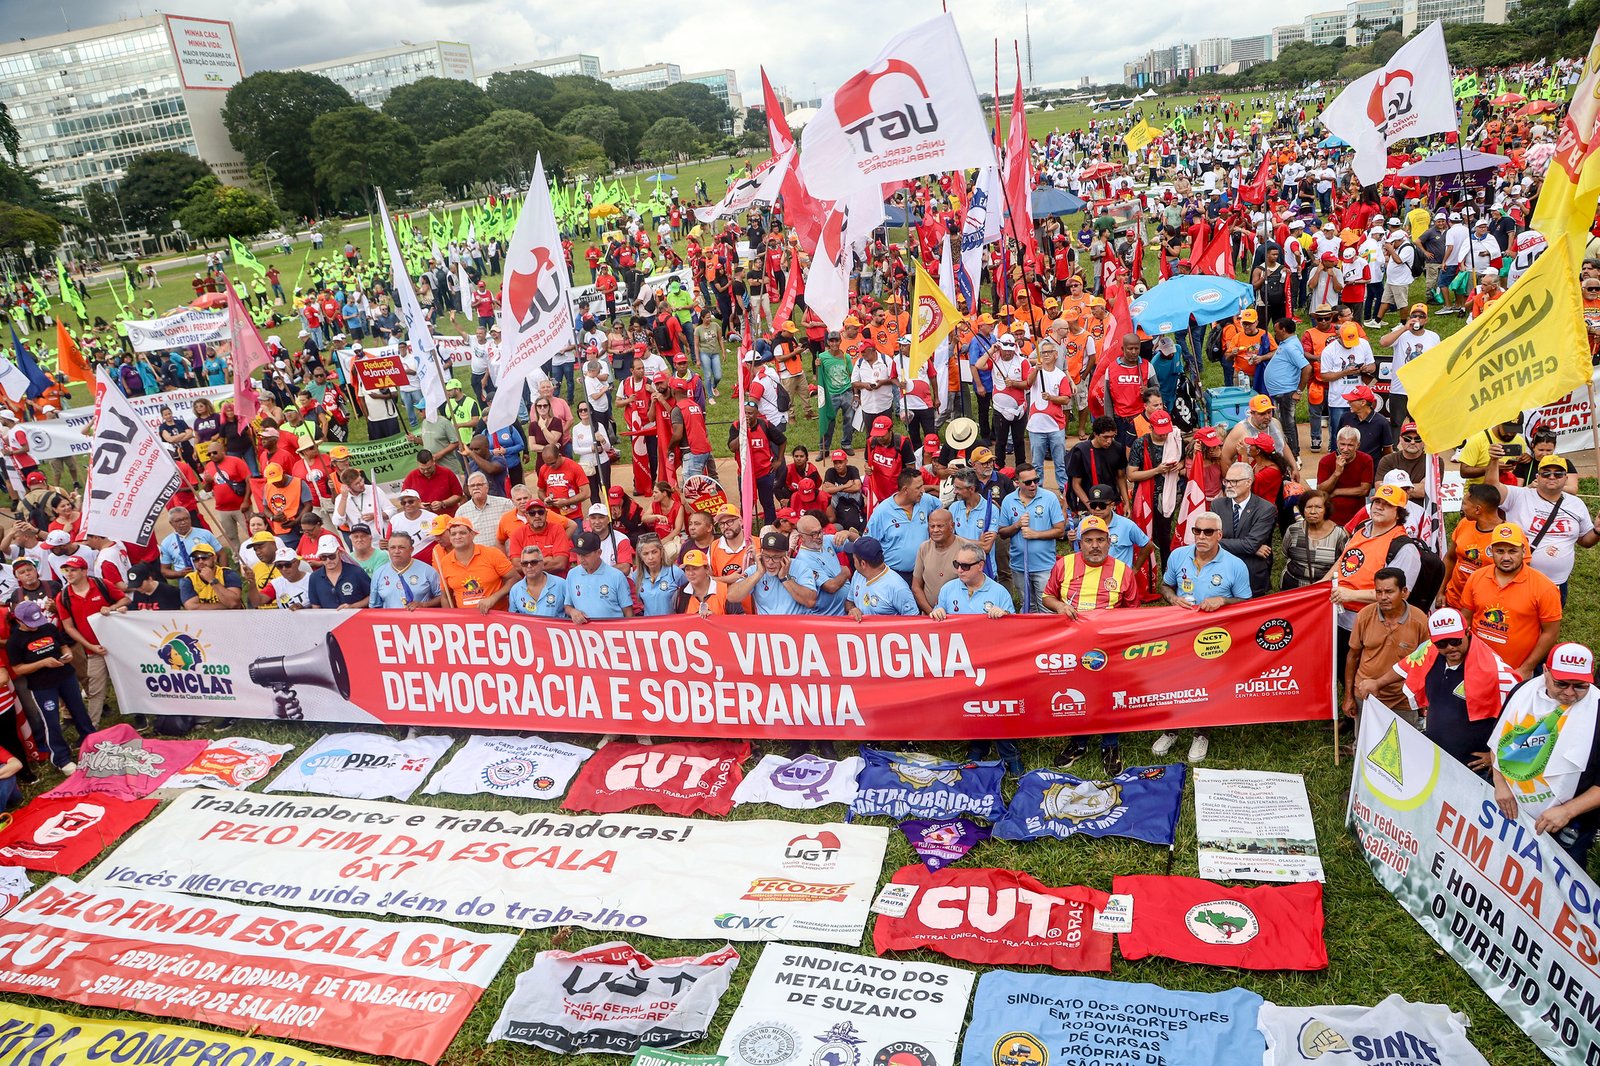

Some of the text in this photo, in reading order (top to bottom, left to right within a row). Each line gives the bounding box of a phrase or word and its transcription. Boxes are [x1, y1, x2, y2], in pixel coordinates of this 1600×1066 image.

[184, 29, 203, 37] MINHA
[188, 40, 207, 48] MINHA
[182, 58, 208, 66] HABITAÇÃO
[164, 325, 190, 337] CONTRA
[166, 338, 175, 346] NO
[363, 360, 393, 370] Redução
[369, 367, 400, 377] Jornada
[1118, 375, 1139, 383] CUT
[390, 448, 418, 460] ESCALA
[872, 452, 895, 465] CUT
[373, 463, 394, 474] 6X1
[1433, 617, 1455, 628] LULA
[1479, 620, 1509, 633] CONCLAT
[1202, 634, 1224, 642] NCST
[1256, 634, 1292, 650] SINDICAL
[371, 622, 987, 687] EMPREGO, DIREITOS, VIDA DIGNA,
[1124, 640, 1169, 661] CTB
[1200, 649, 1225, 657] CENTRAL
[1035, 653, 1078, 670] CSB
[1560, 654, 1587, 666] LULA
[140, 663, 230, 675] 2026 2030
[146, 672, 233, 695] CONCLAT
[1235, 678, 1299, 693] PÚBLICA
[381, 670, 866, 726] DEMOCRACIA E SOBERANIA
[1129, 687, 1209, 705] INTERSINDICAL
[1173, 696, 1209, 704] Trabalhadora
[963, 700, 1018, 714] CUT
[1051, 702, 1083, 712] UGT
[1519, 736, 1546, 749] APR
[605, 751, 720, 791] CUT
[782, 767, 821, 779] CUT
[191, 794, 694, 843] Trabalhadores e Trabalhadoras!
[1373, 811, 1419, 856] redução
[1478, 799, 1543, 873] STIA
[199, 820, 618, 874] PELO FIM DA ESCALA
[784, 847, 839, 862] UGT
[1363, 833, 1410, 878] salário!
[1435, 800, 1544, 920] FIM DA
[747, 879, 851, 895] FECOMSE
[104, 866, 649, 929] Vocês Merecem vida além do trabalho
[917, 886, 1066, 939] CUT
[1430, 851, 1544, 971] É HORA DE
[18, 885, 494, 972] PELO FIM DA ESCALA 6X1
[722, 915, 785, 930] CNTC
[792, 924, 831, 932] TRABALHADORES
[793, 919, 829, 928] CONFEDERAÇÃO
[950, 932, 978, 940] ÚNICA
[782, 955, 949, 986] SINDICATO DOS
[1432, 893, 1580, 1048] O DIREITO AO
[115, 949, 455, 1014] REDUÇÃO DA JORNADA DE TRABALHO!
[774, 971, 945, 1004] METALÚRGICOS
[87, 976, 325, 1028] SEM REDUÇÃO DE SALÁRIO!
[603, 1001, 678, 1013] GERAL DOS
[787, 992, 917, 1020] DE SUZANO
[1007, 993, 1229, 1024] SINDICATO DOS CONDUTORES
[1049, 1008, 1188, 1031] EM TRANSPORTES
[535, 1029, 566, 1041] UGT
[640, 1032, 672, 1042] UGT
[1062, 1021, 1170, 1042] RODOVIÁRIOS
[1069, 1032, 1161, 1052] DE CARGAS
[1352, 1030, 1442, 1066] SINTE
[886, 1043, 930, 1062] FORÇA
[1060, 1043, 1167, 1066] PRÓPRIAS DE
